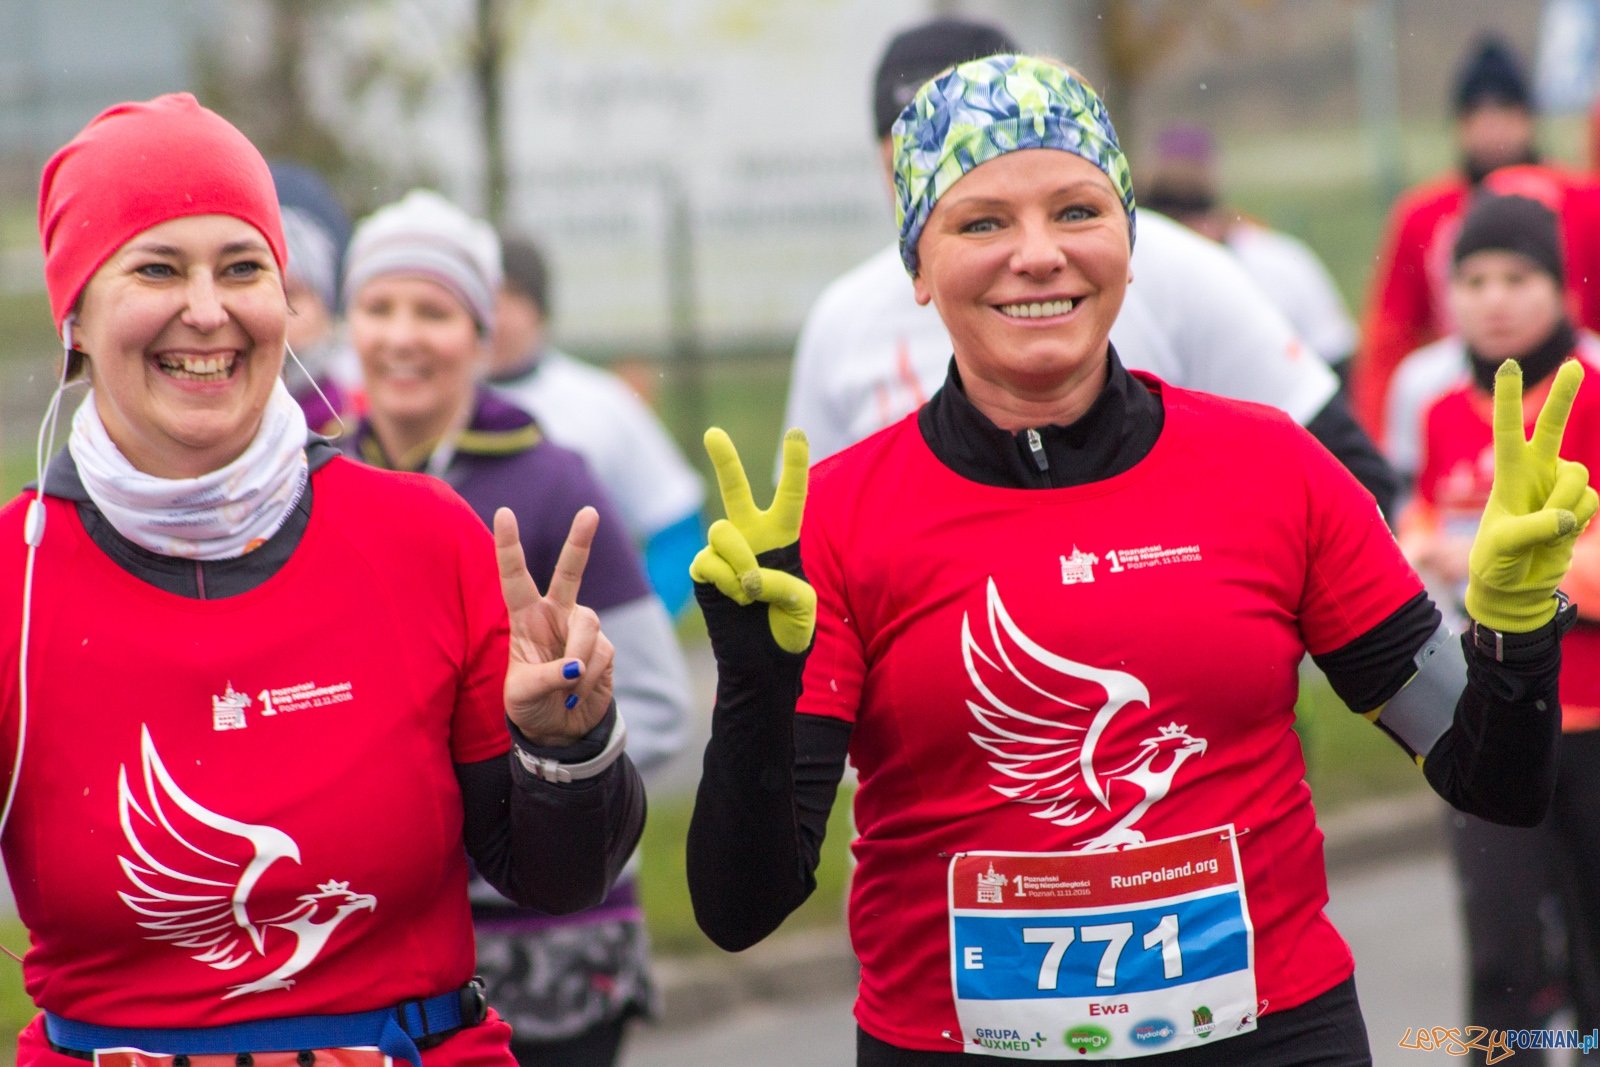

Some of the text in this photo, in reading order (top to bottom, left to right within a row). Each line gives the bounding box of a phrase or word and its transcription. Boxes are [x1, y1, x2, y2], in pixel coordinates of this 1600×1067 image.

[1118, 544, 1162, 557] Poznański
[1105, 550, 1124, 573] 1
[1119, 553, 1139, 563] Bieg
[1162, 553, 1202, 565] 11.11.2016
[257, 689, 277, 717] 1
[1111, 858, 1218, 889] RunPoland.org
[1012, 874, 1027, 897] 1
[1024, 882, 1040, 890] Bieg
[1056, 889, 1091, 897] 11.11.2016
[963, 946, 984, 970] E
[1022, 913, 1183, 990] 771
[1089, 1002, 1129, 1017] Ewa
[976, 1028, 1021, 1040] GRUPA
[1193, 1023, 1216, 1034] LIMARO
[978, 1037, 1030, 1051] LUXMED
[1071, 1035, 1107, 1047] energy
